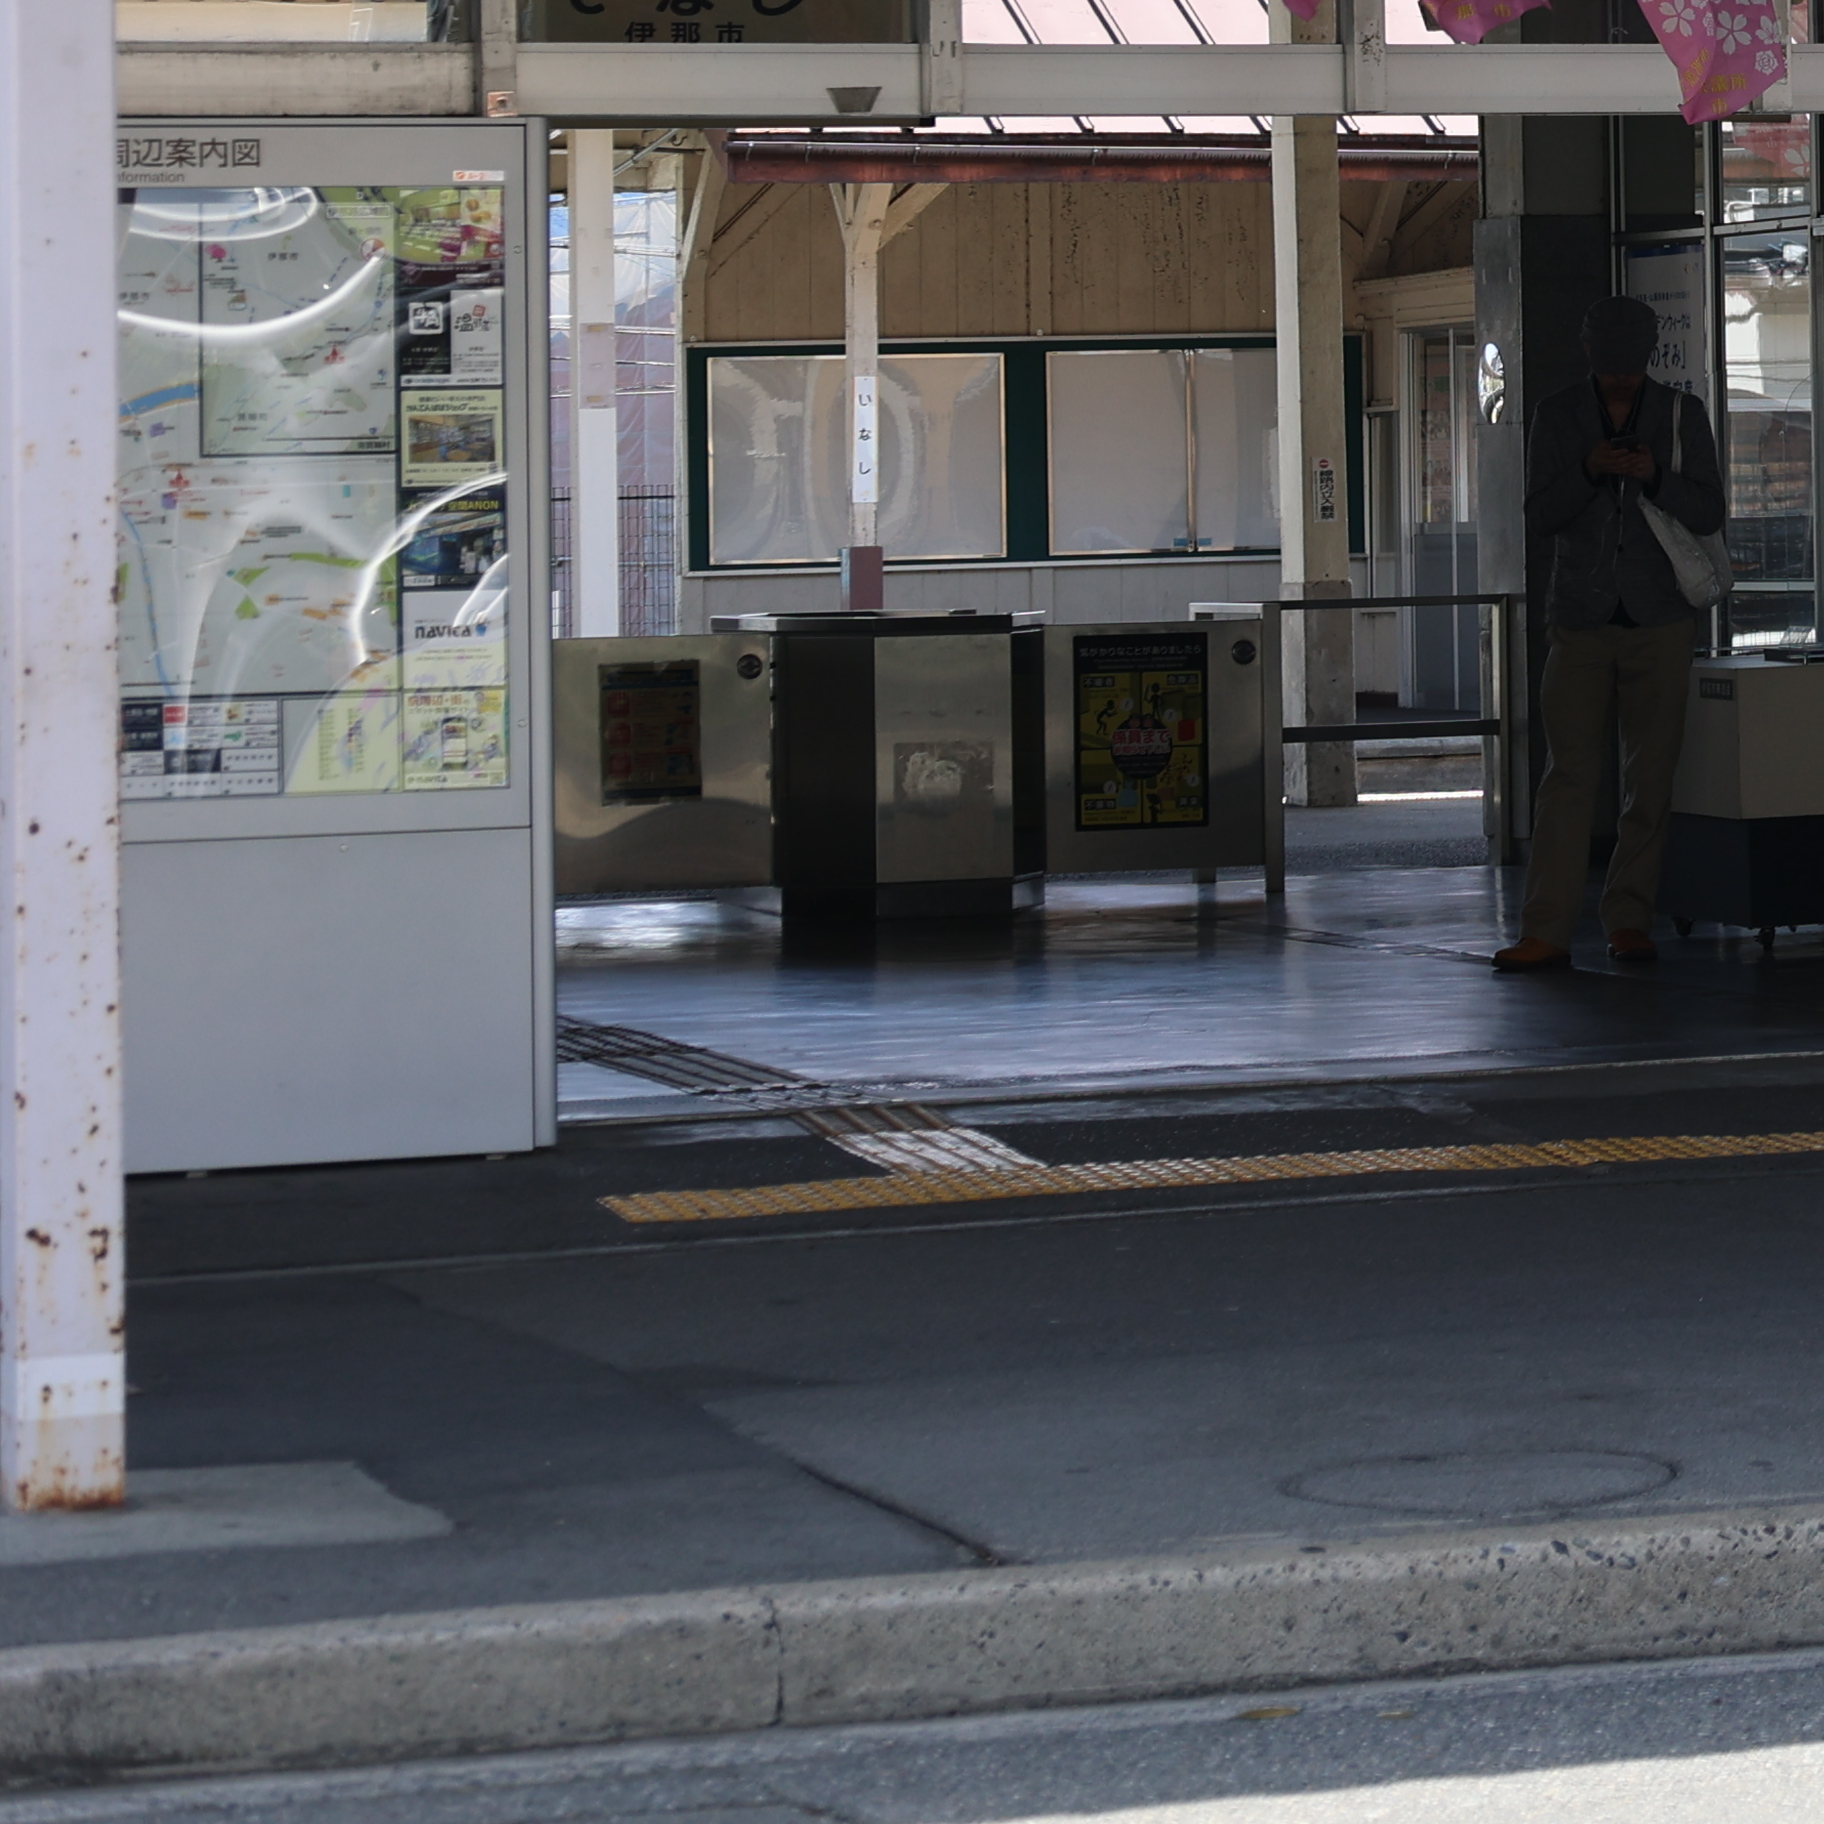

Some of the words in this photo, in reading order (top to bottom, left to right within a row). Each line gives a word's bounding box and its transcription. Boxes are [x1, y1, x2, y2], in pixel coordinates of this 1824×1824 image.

[625, 21, 745, 43] 伊那市
[117, 170, 186, 183] nformation
[858, 394, 872, 475] いなし
